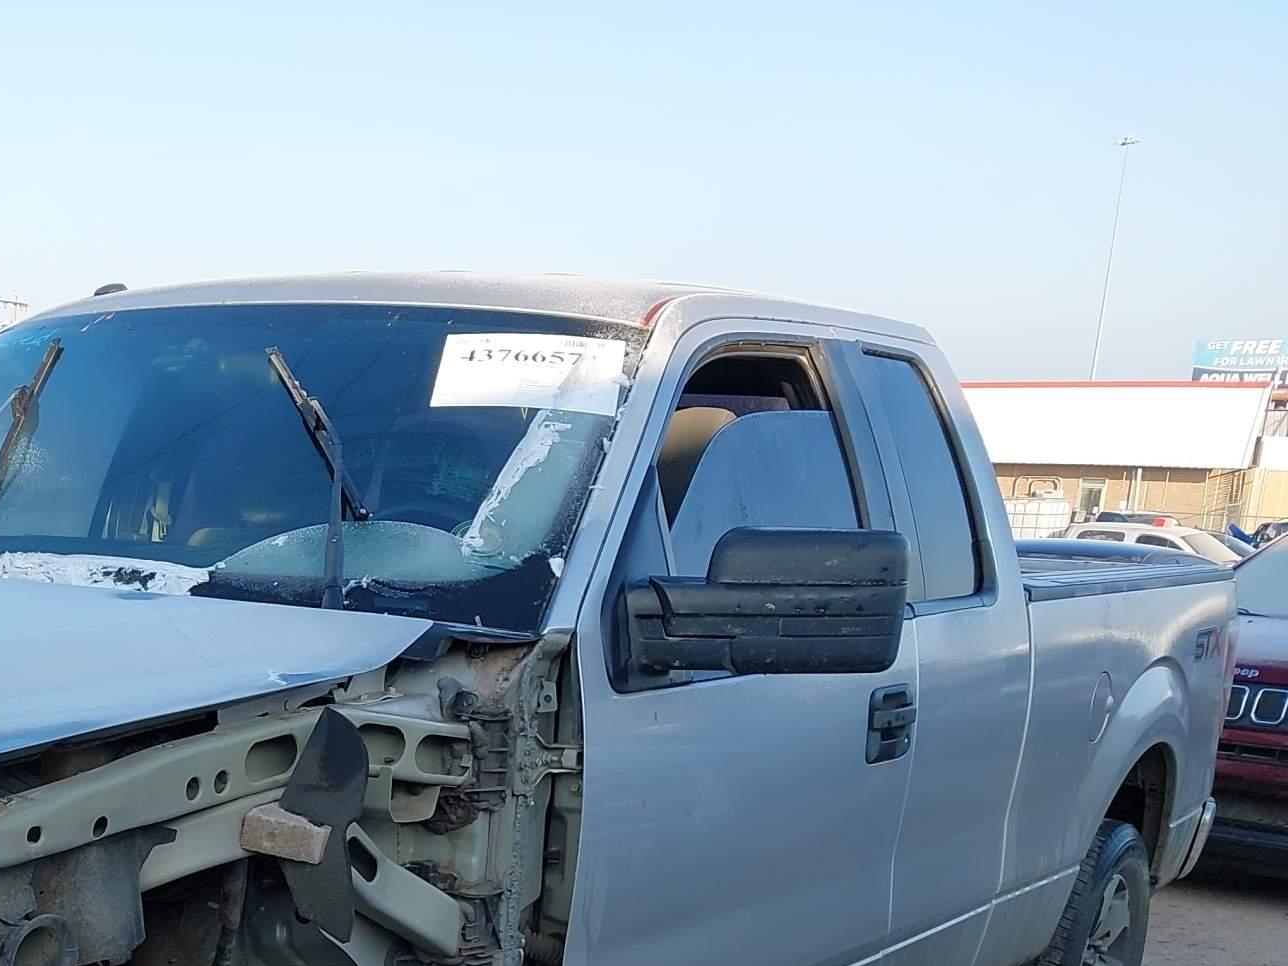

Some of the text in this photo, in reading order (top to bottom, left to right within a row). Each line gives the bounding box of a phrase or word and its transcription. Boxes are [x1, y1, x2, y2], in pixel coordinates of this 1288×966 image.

[1207, 339, 1284, 355] GET FREE
[461, 349, 597, 366] 4376657
[1214, 356, 1238, 367] FOR
[1239, 356, 1274, 367] LAWN
[1194, 627, 1224, 662] STX
